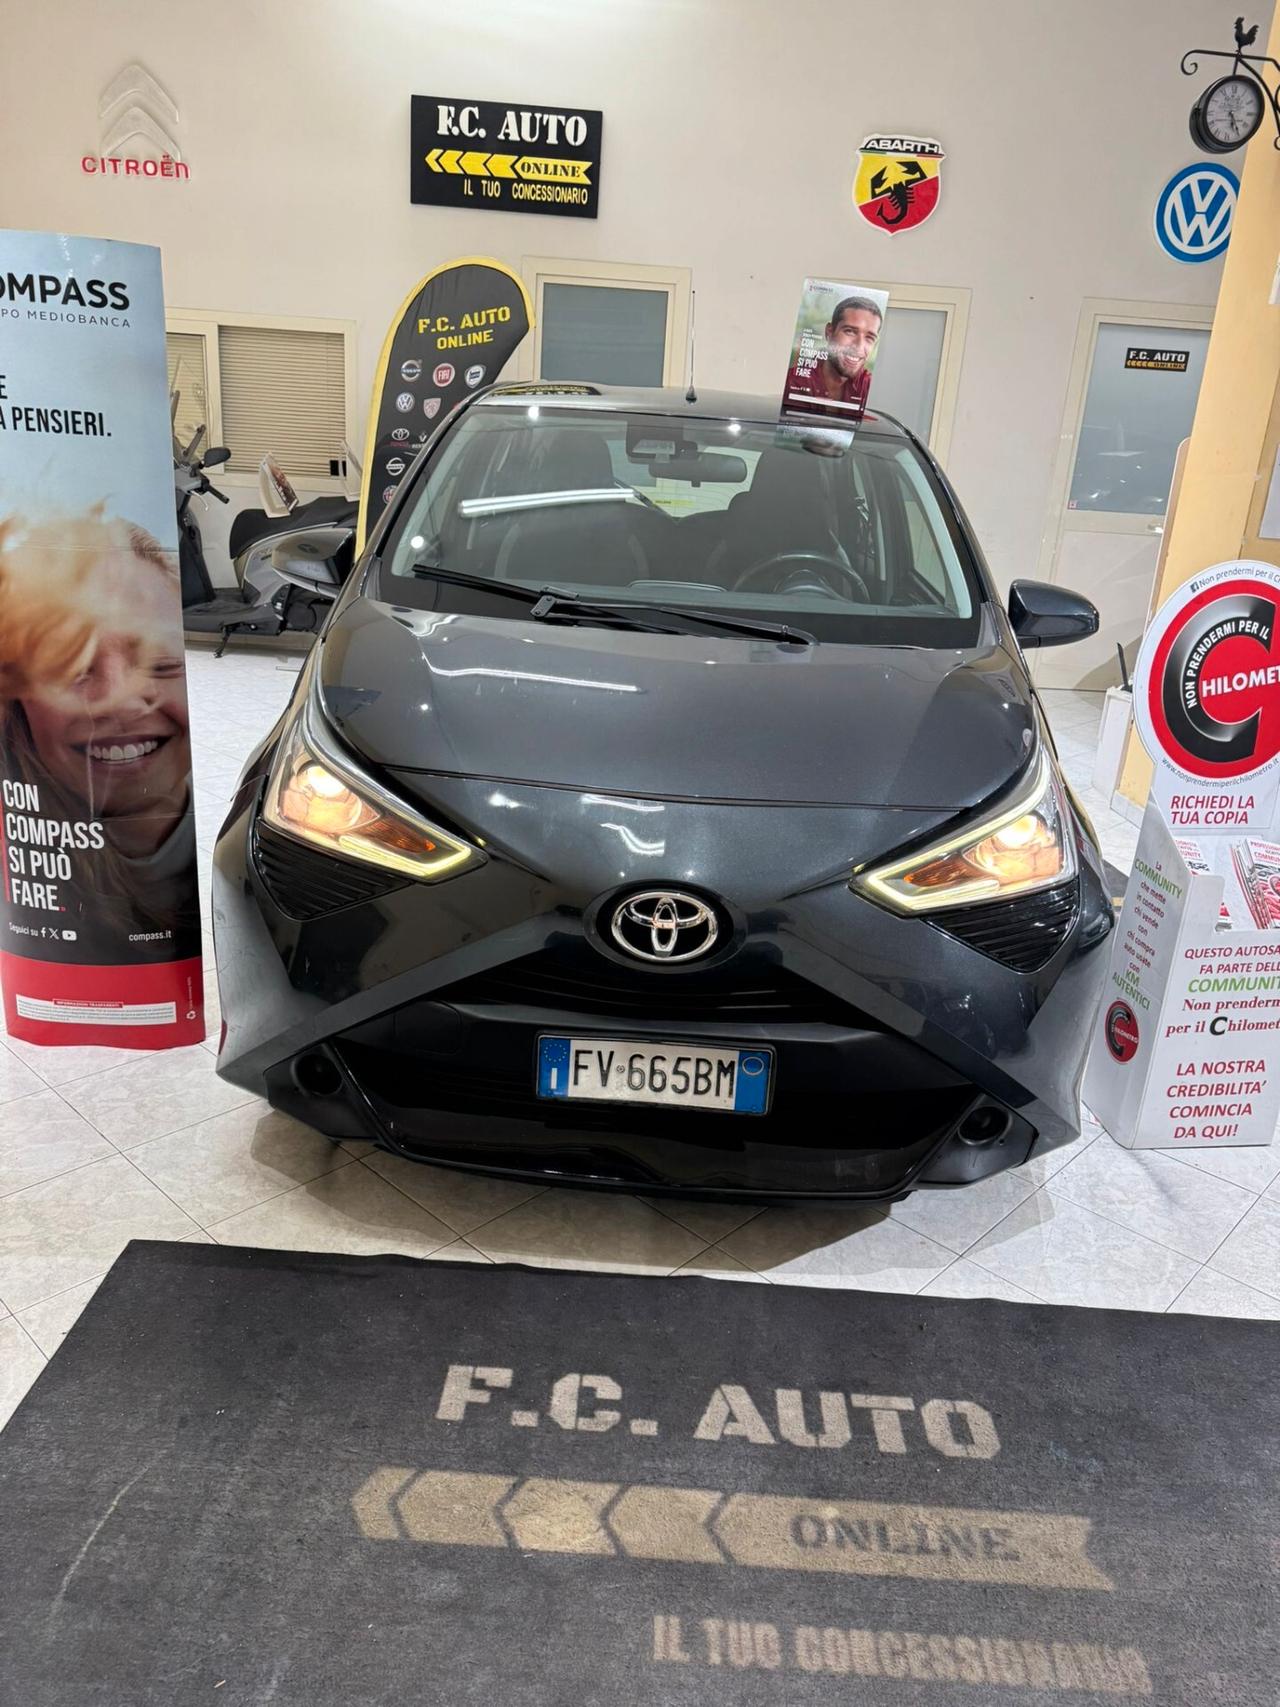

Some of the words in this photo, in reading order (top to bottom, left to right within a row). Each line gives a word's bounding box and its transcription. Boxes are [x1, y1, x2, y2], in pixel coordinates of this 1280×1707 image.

[437, 104, 486, 139] F.C.
[497, 110, 588, 147] AUTO
[866, 139, 938, 153] ABARTH
[520, 161, 581, 178] ONLINE
[463, 178, 474, 196] IL
[480, 180, 501, 198] TUO
[511, 182, 588, 205] CONCESSIONARIO
[0, 272, 130, 311] MPASS
[27, 310, 131, 328] MEDIOBANCA
[417, 316, 455, 334] F.C.
[460, 305, 511, 330] AUTO
[436, 329, 494, 350] ONLINE
[1129, 350, 1150, 360] F.C.
[1153, 352, 1186, 362] AUTO
[11, 406, 112, 437] PENSIERI.
[1216, 566, 1254, 580] prendermi
[1238, 619, 1259, 635] PER
[1259, 625, 1270, 641] IL
[1186, 621, 1236, 677] PRENDERMI
[1185, 681, 1198, 709] NON
[3, 779, 40, 813] CON
[1170, 795, 1234, 810] RICHIEDI
[1237, 795, 1255, 810] LA
[1171, 811, 1200, 825] TUA
[1204, 811, 1249, 825] COPIA
[5, 812, 105, 849] COMPASS
[8, 846, 26, 875] SI
[29, 847, 72, 881] PUÒ
[1134, 859, 1182, 899] COMMUNITY
[128, 930, 172, 942] compass.it
[1184, 946, 1233, 960] QUESTO
[1199, 964, 1213, 975] FA
[1216, 962, 1253, 974] PARTE
[1125, 969, 1140, 987] KM
[1112, 971, 1151, 1010] AUTENTICI
[1182, 998, 1211, 1012] Non
[1165, 1024, 1191, 1038] per
[1194, 1019, 1206, 1033] il
[1176, 1062, 1196, 1077] LA
[1201, 1059, 1266, 1076] NOSTRA
[1169, 1103, 1253, 1119] COMINCIA
[1174, 1126, 1196, 1139] DA
[1201, 1123, 1239, 1138] QUI!
[435, 1364, 659, 1436] F.C.
[692, 1383, 1001, 1460] AUTO
[790, 1513, 1020, 1562] ONLINE
[652, 1614, 691, 1665] IL
[702, 1616, 782, 1670] TUO
